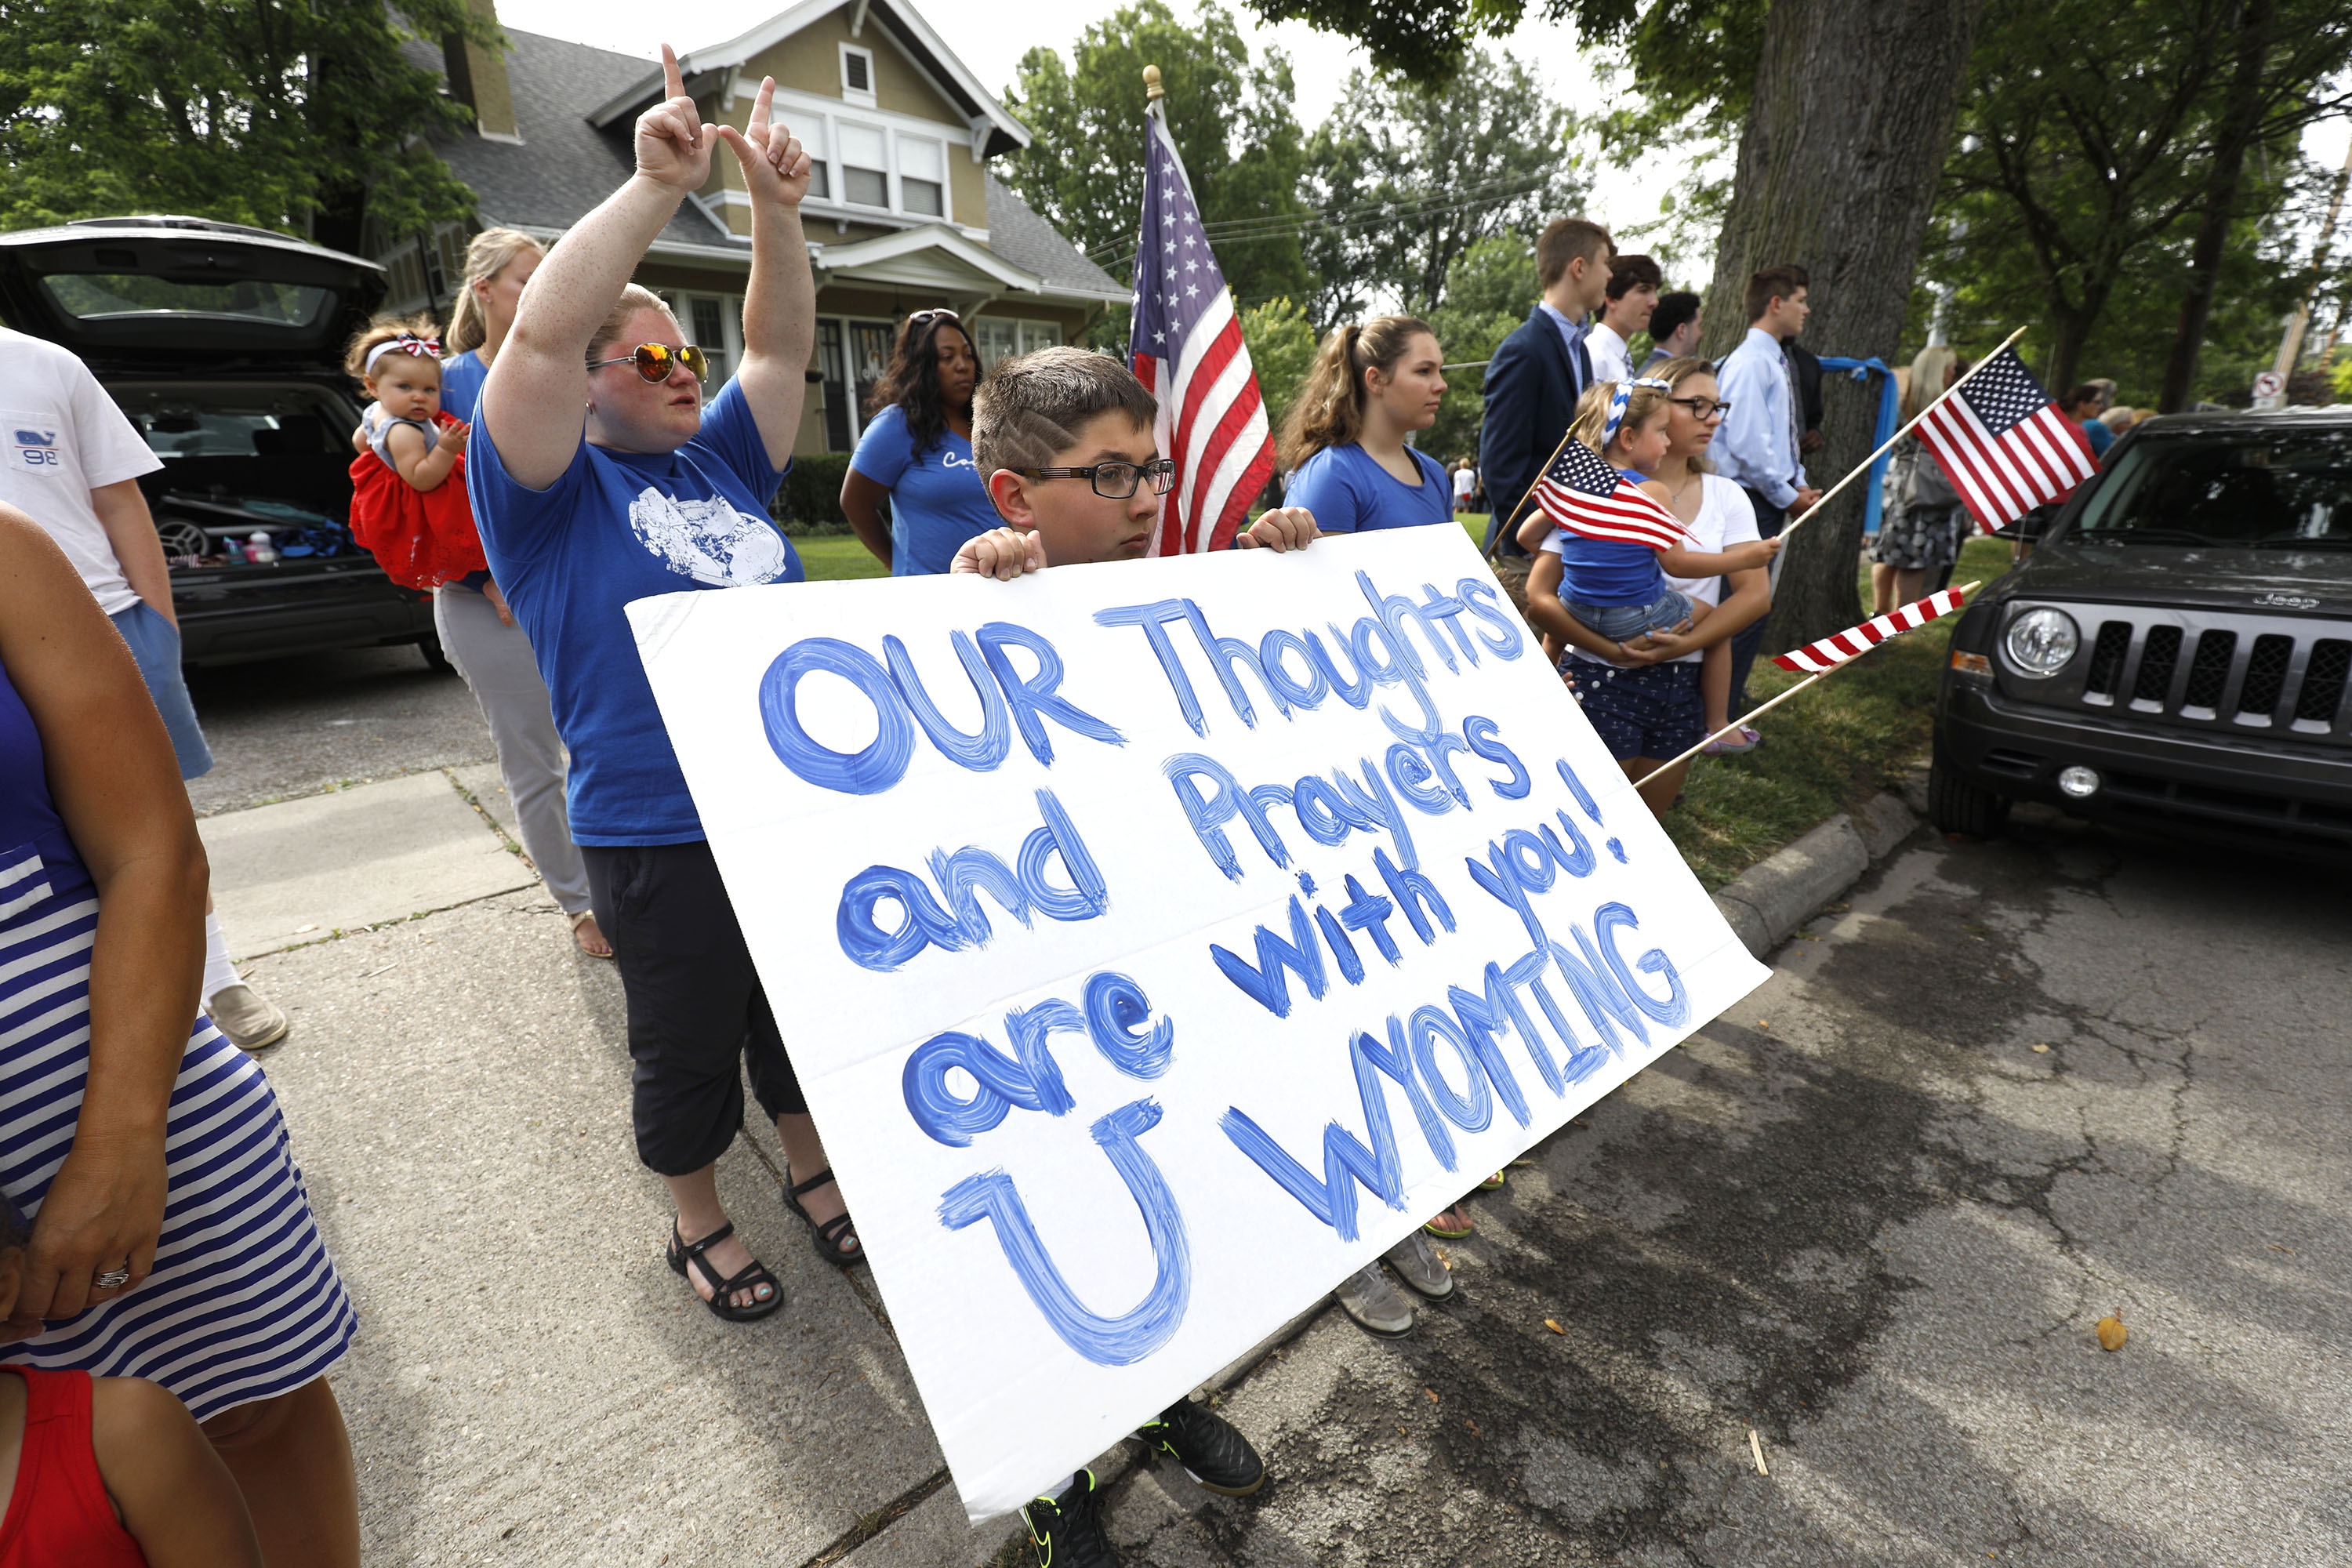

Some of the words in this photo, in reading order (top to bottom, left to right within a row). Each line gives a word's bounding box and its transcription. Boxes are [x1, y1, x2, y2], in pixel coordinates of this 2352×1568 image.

[23, 450, 59, 465] 98
[759, 622, 1131, 795] OUR
[1092, 569, 1524, 747] Thoughts
[2252, 593, 2320, 609] Jeep
[837, 788, 1109, 973] and
[1160, 714, 1531, 885] Prayers
[902, 971, 1174, 1148] are
[1465, 757, 1629, 956] you!
[938, 1095, 1192, 1367] U
[1216, 901, 1692, 1243] WYOMING
